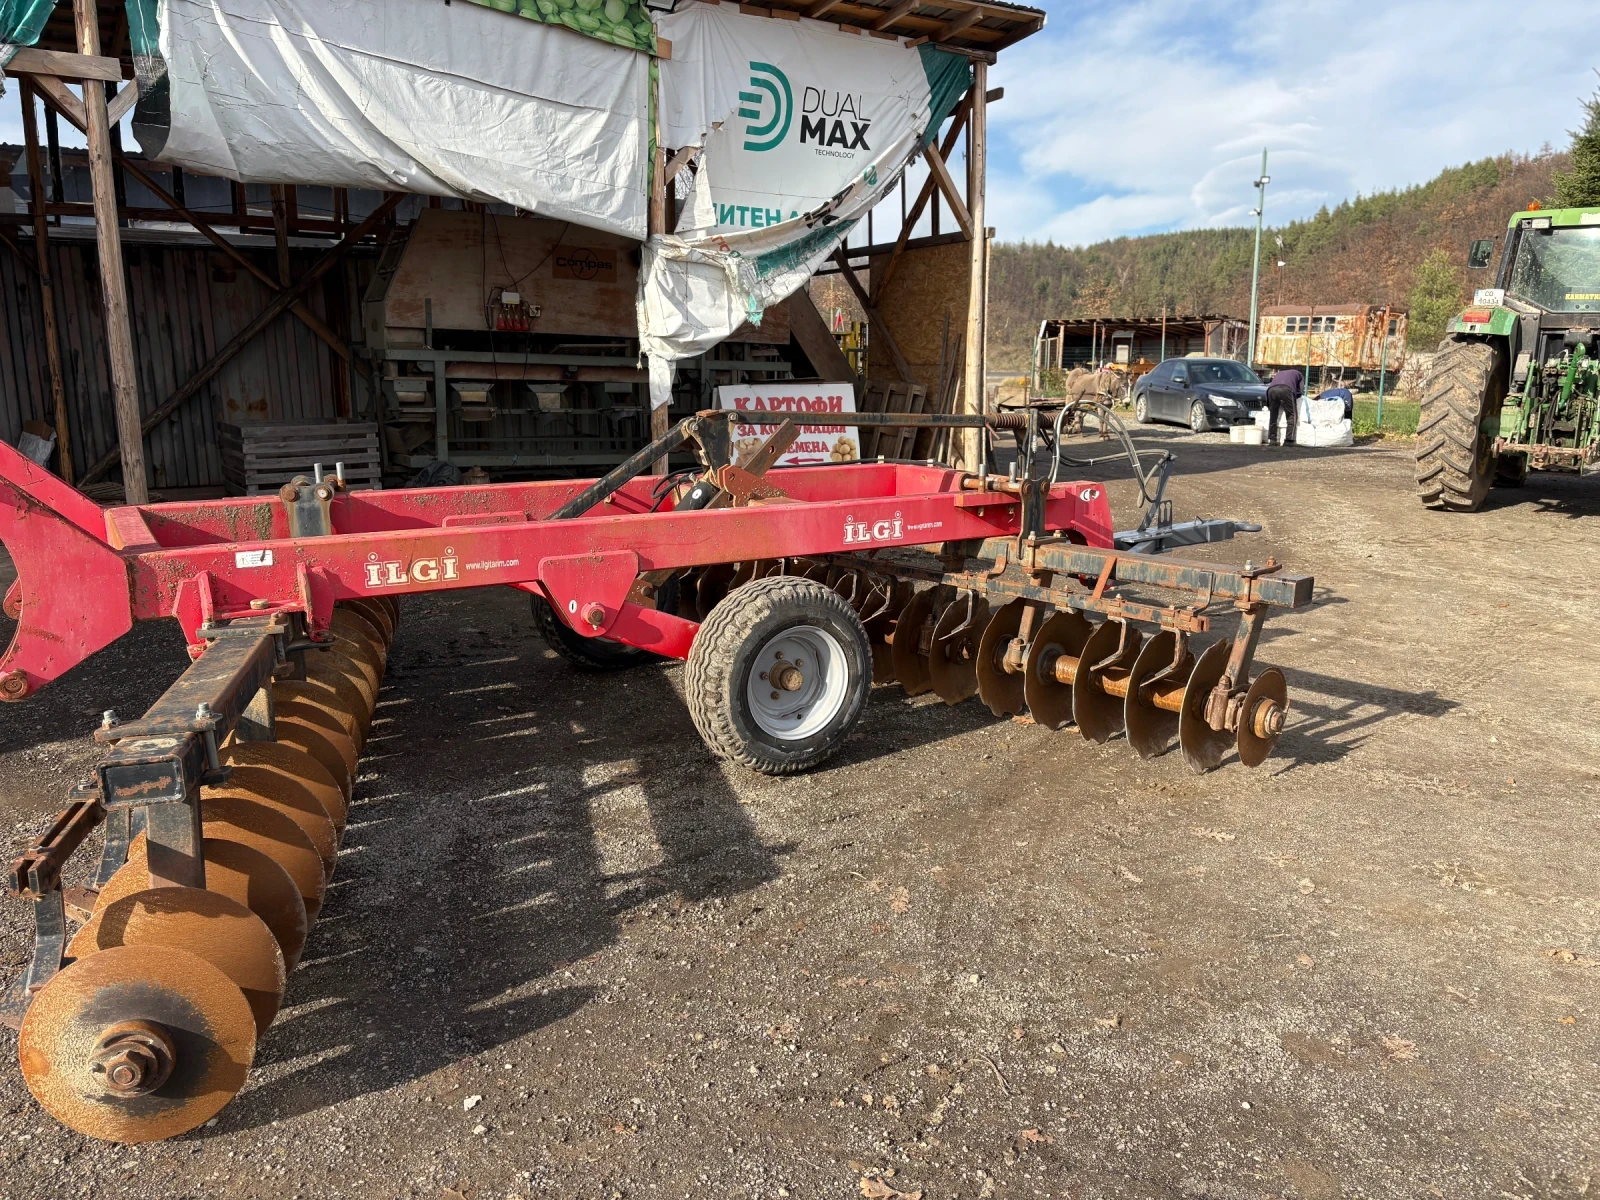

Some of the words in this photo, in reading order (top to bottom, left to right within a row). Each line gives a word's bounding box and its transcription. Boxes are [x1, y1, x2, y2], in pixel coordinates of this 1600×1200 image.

[803, 86, 871, 122] DUAL
[800, 114, 871, 151] MAX
[815, 148, 855, 159] TECHNOLOGY
[555, 257, 612, 270] Compas
[737, 424, 757, 437] ЗА
[465, 558, 519, 571] www.ilgitarim.com
